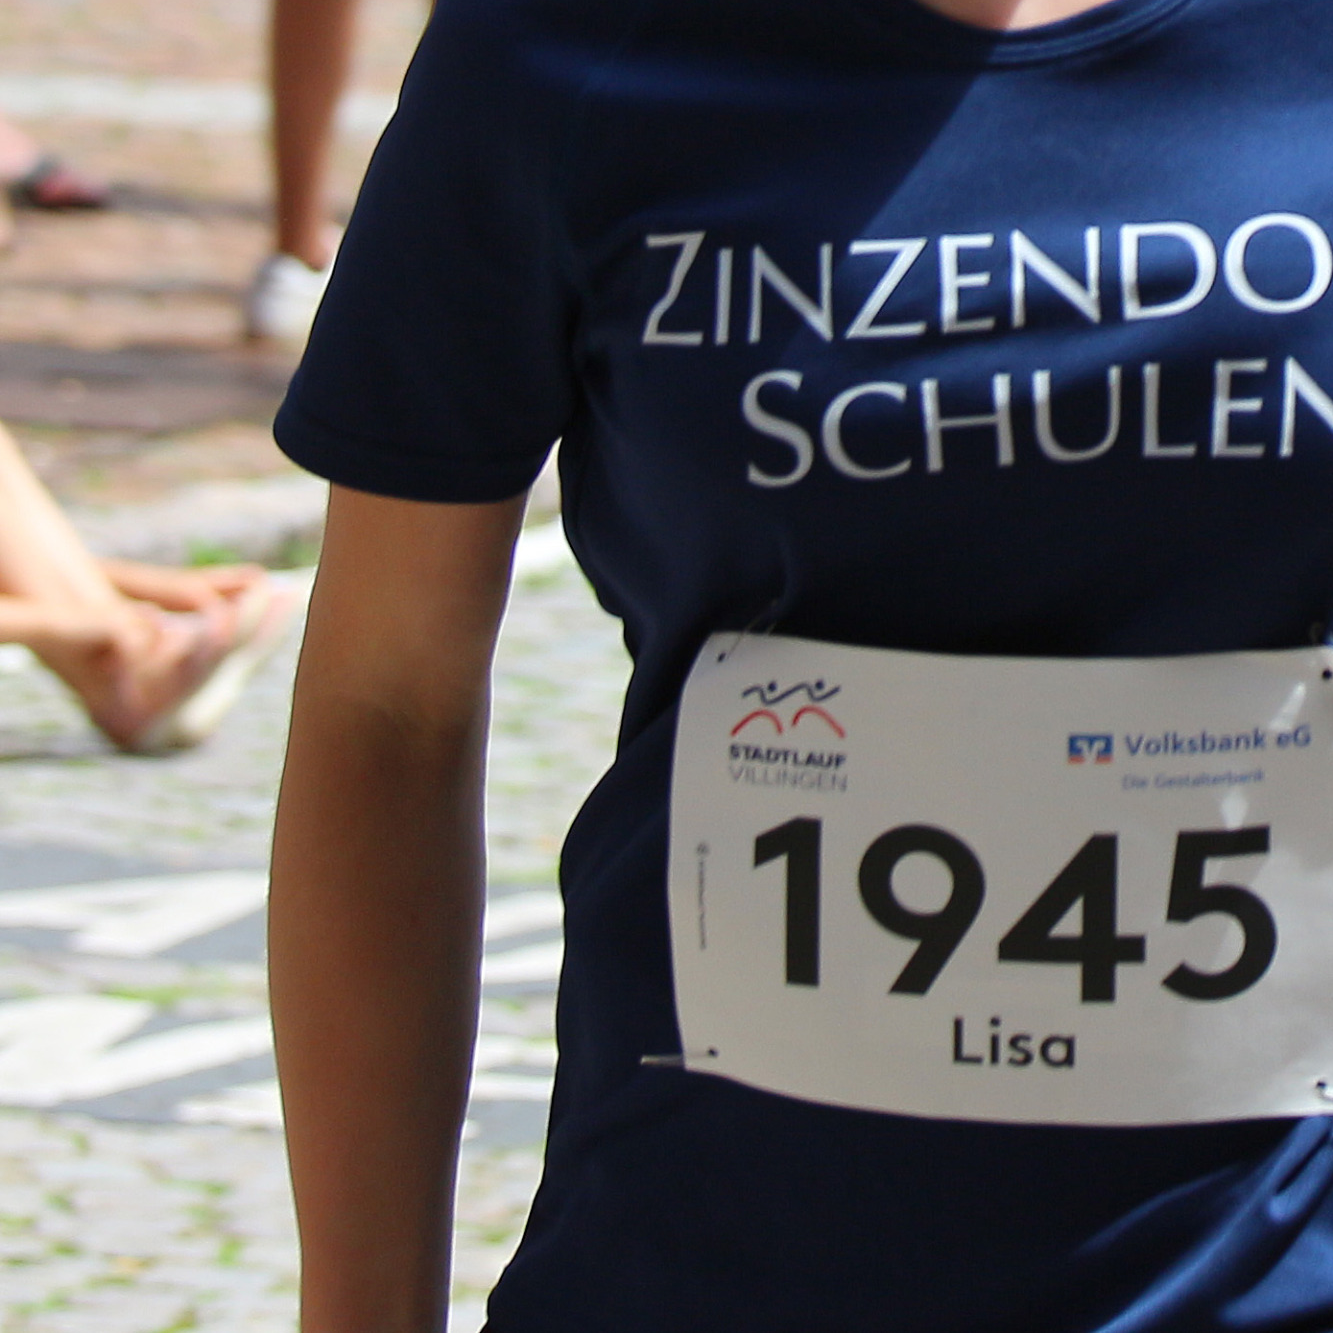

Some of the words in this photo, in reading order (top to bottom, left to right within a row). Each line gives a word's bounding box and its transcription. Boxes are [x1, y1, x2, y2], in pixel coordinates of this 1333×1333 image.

[729, 744, 846, 769] STADTLAUF
[1125, 726, 1266, 757] Volksbank
[1277, 723, 1312, 749] eG
[753, 816, 1278, 1004] 1945
[953, 1017, 1077, 1068] Lisa
